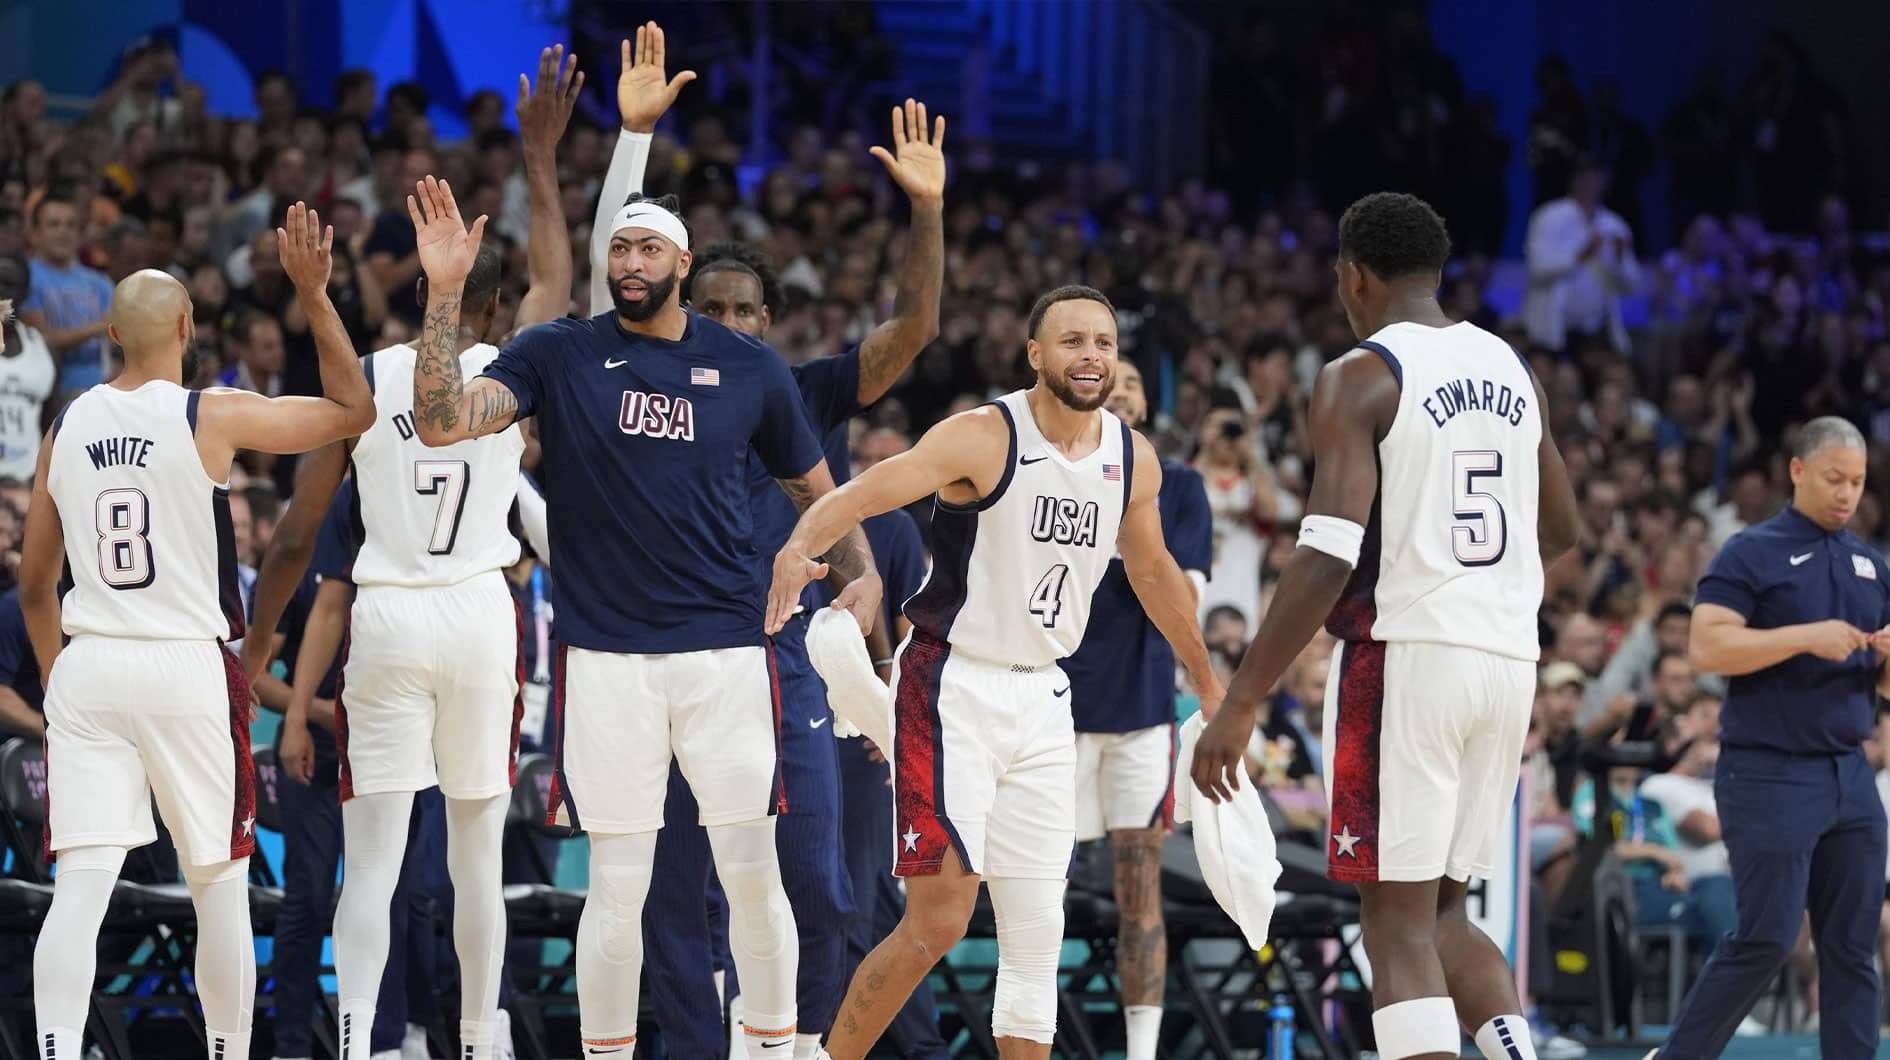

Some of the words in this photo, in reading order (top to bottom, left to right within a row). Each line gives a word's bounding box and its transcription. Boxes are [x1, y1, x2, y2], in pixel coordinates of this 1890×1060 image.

[619, 390, 695, 442] USA
[1423, 378, 1526, 429] EDWARDS
[85, 436, 154, 471] WHITE
[415, 459, 471, 556] 7
[1031, 495, 1099, 548] USA
[1451, 450, 1507, 568] 5
[95, 487, 156, 591] 8
[1029, 563, 1069, 628] 4
